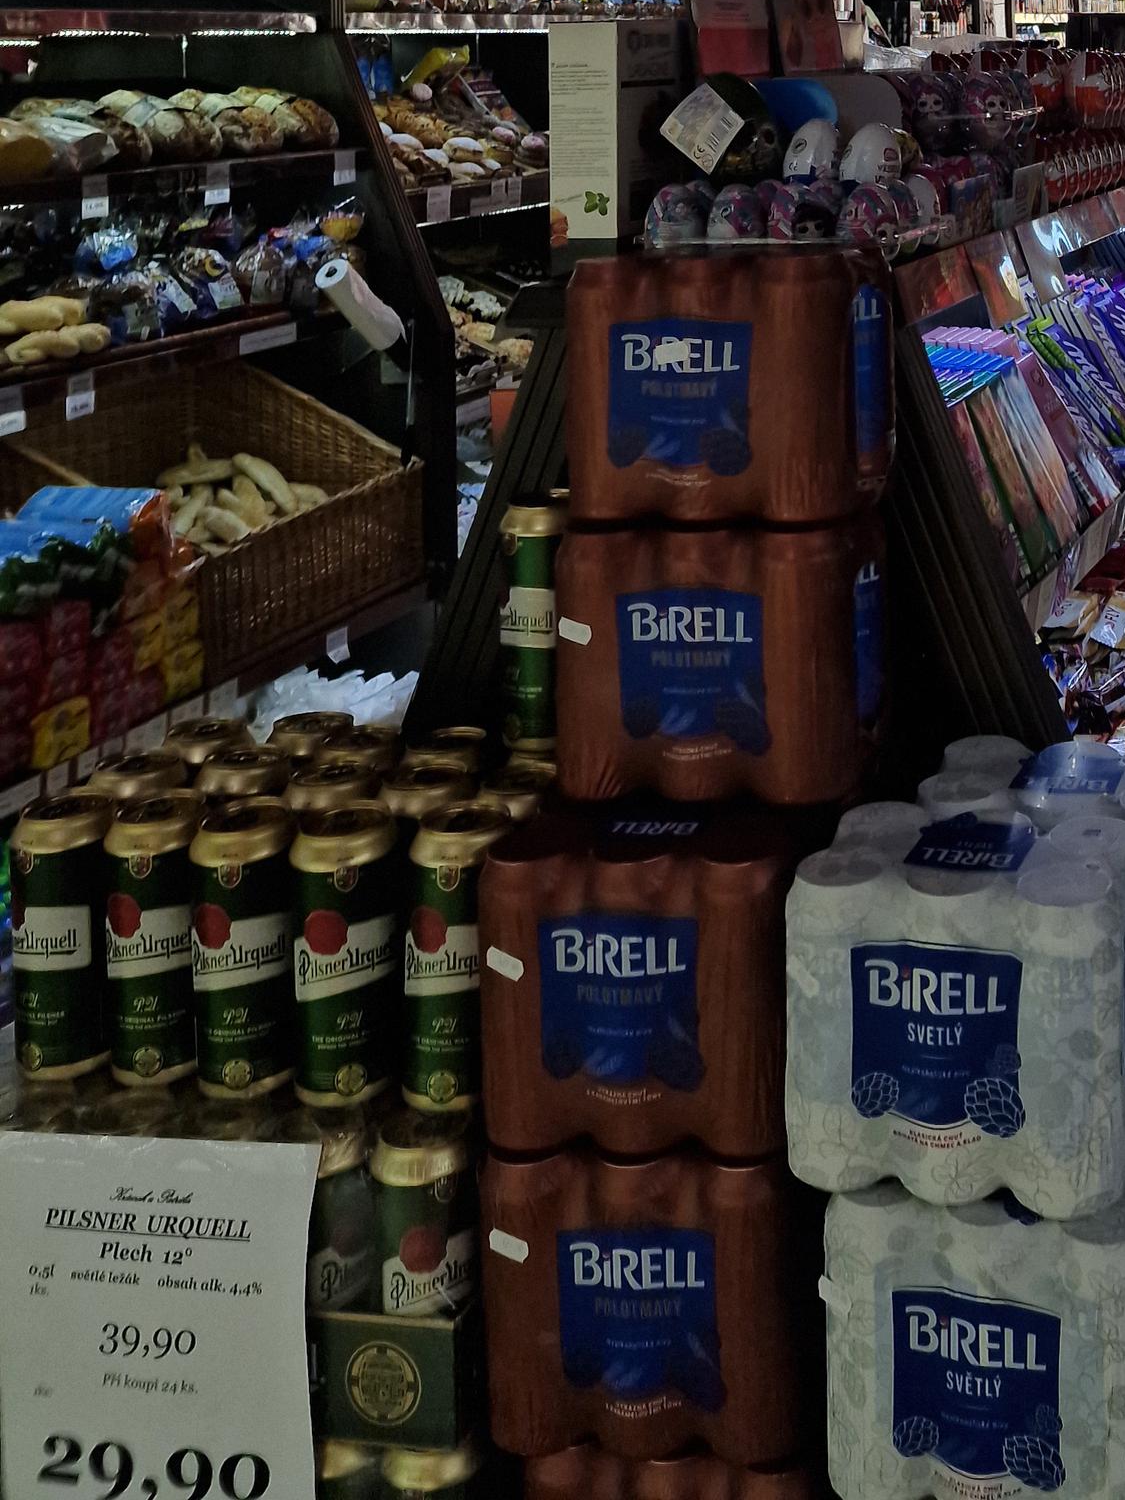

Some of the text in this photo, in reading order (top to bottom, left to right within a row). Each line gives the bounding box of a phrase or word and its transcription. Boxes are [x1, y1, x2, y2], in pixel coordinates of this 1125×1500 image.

[627, 602, 754, 643] BiRELL
[923, 848, 1015, 869] BiRELL
[299, 950, 348, 985] Pilsner
[551, 928, 687, 979] BiRELL
[864, 958, 1007, 1016] BiRELL
[46, 1208, 251, 1239] PILSNER URQUELL
[99, 1242, 152, 1263] Plech
[569, 1241, 705, 1291] BiRELL
[108, 1269, 140, 1286] ležák
[157, 1274, 198, 1291] obsah
[229, 1281, 263, 1298] 4,4%
[390, 1272, 448, 1310] Pilsner
[98, 1323, 197, 1359] 39,90
[905, 1305, 1047, 1372] BiRELL
[161, 1380, 178, 1395] 24
[946, 1370, 1002, 1399] SVĚTLÝ
[37, 1434, 271, 1500] 29,90
